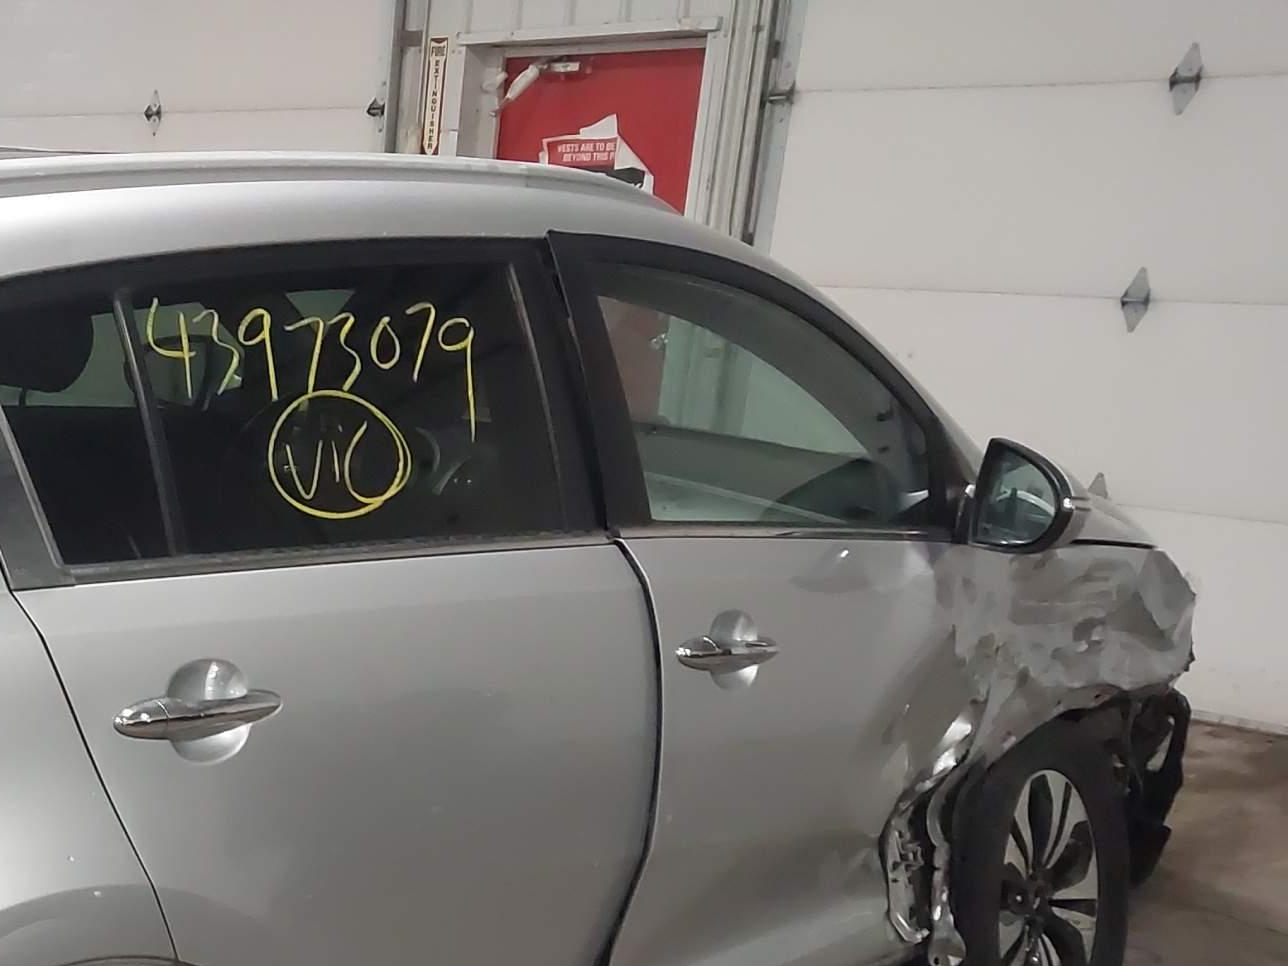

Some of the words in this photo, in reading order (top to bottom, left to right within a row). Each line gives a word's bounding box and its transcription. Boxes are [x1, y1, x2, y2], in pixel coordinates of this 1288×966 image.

[580, 143, 594, 152] ARE
[596, 143, 605, 151] TO
[593, 152, 608, 161] THIS
[146, 297, 477, 443] 43973079
